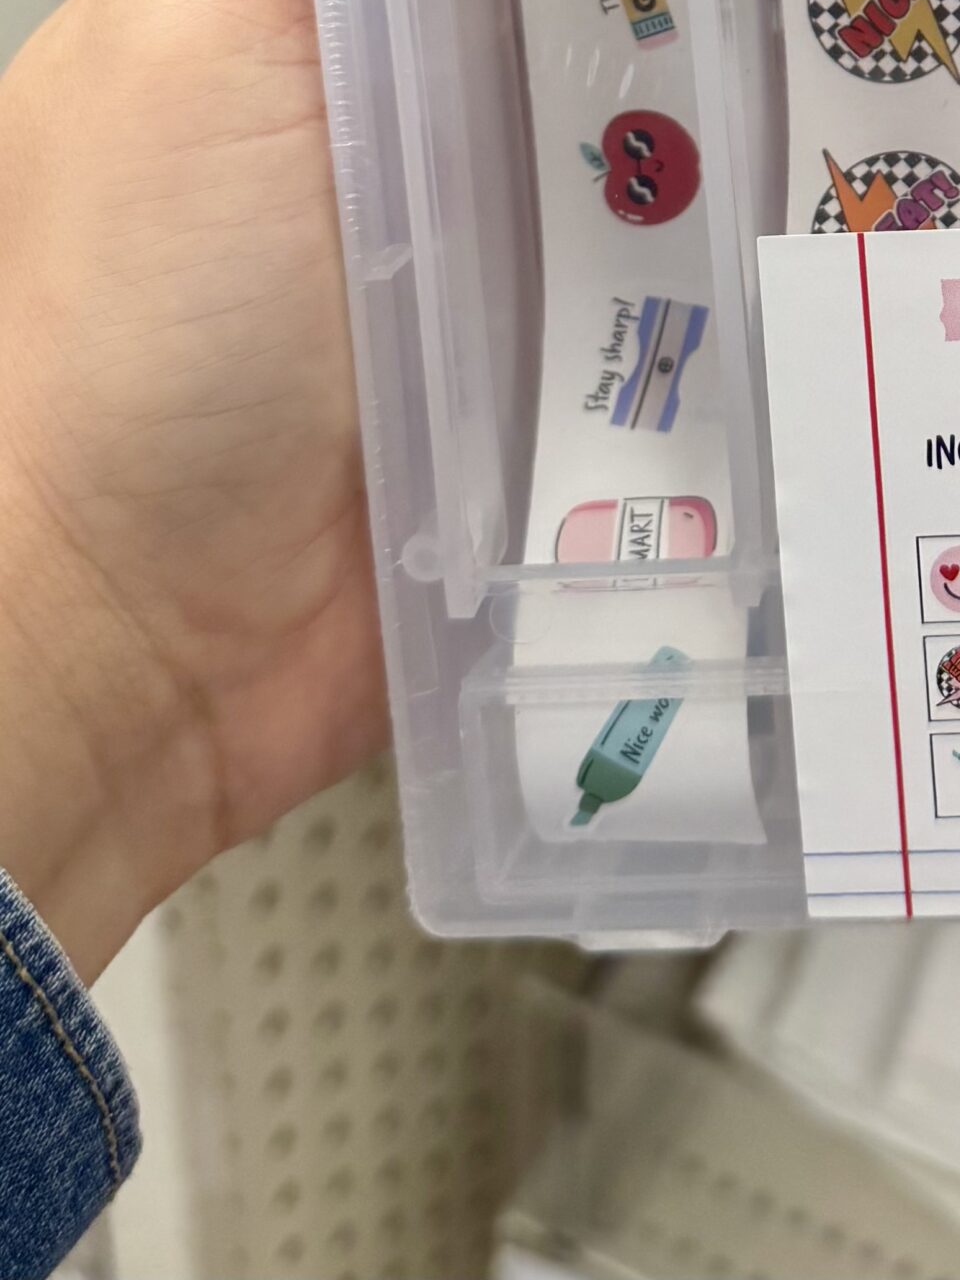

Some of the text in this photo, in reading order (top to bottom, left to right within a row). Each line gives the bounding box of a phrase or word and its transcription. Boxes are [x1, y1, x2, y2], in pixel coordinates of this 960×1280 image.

[583, 369, 625, 411] Stay
[629, 506, 653, 560] MART
[620, 725, 653, 765] Nice
